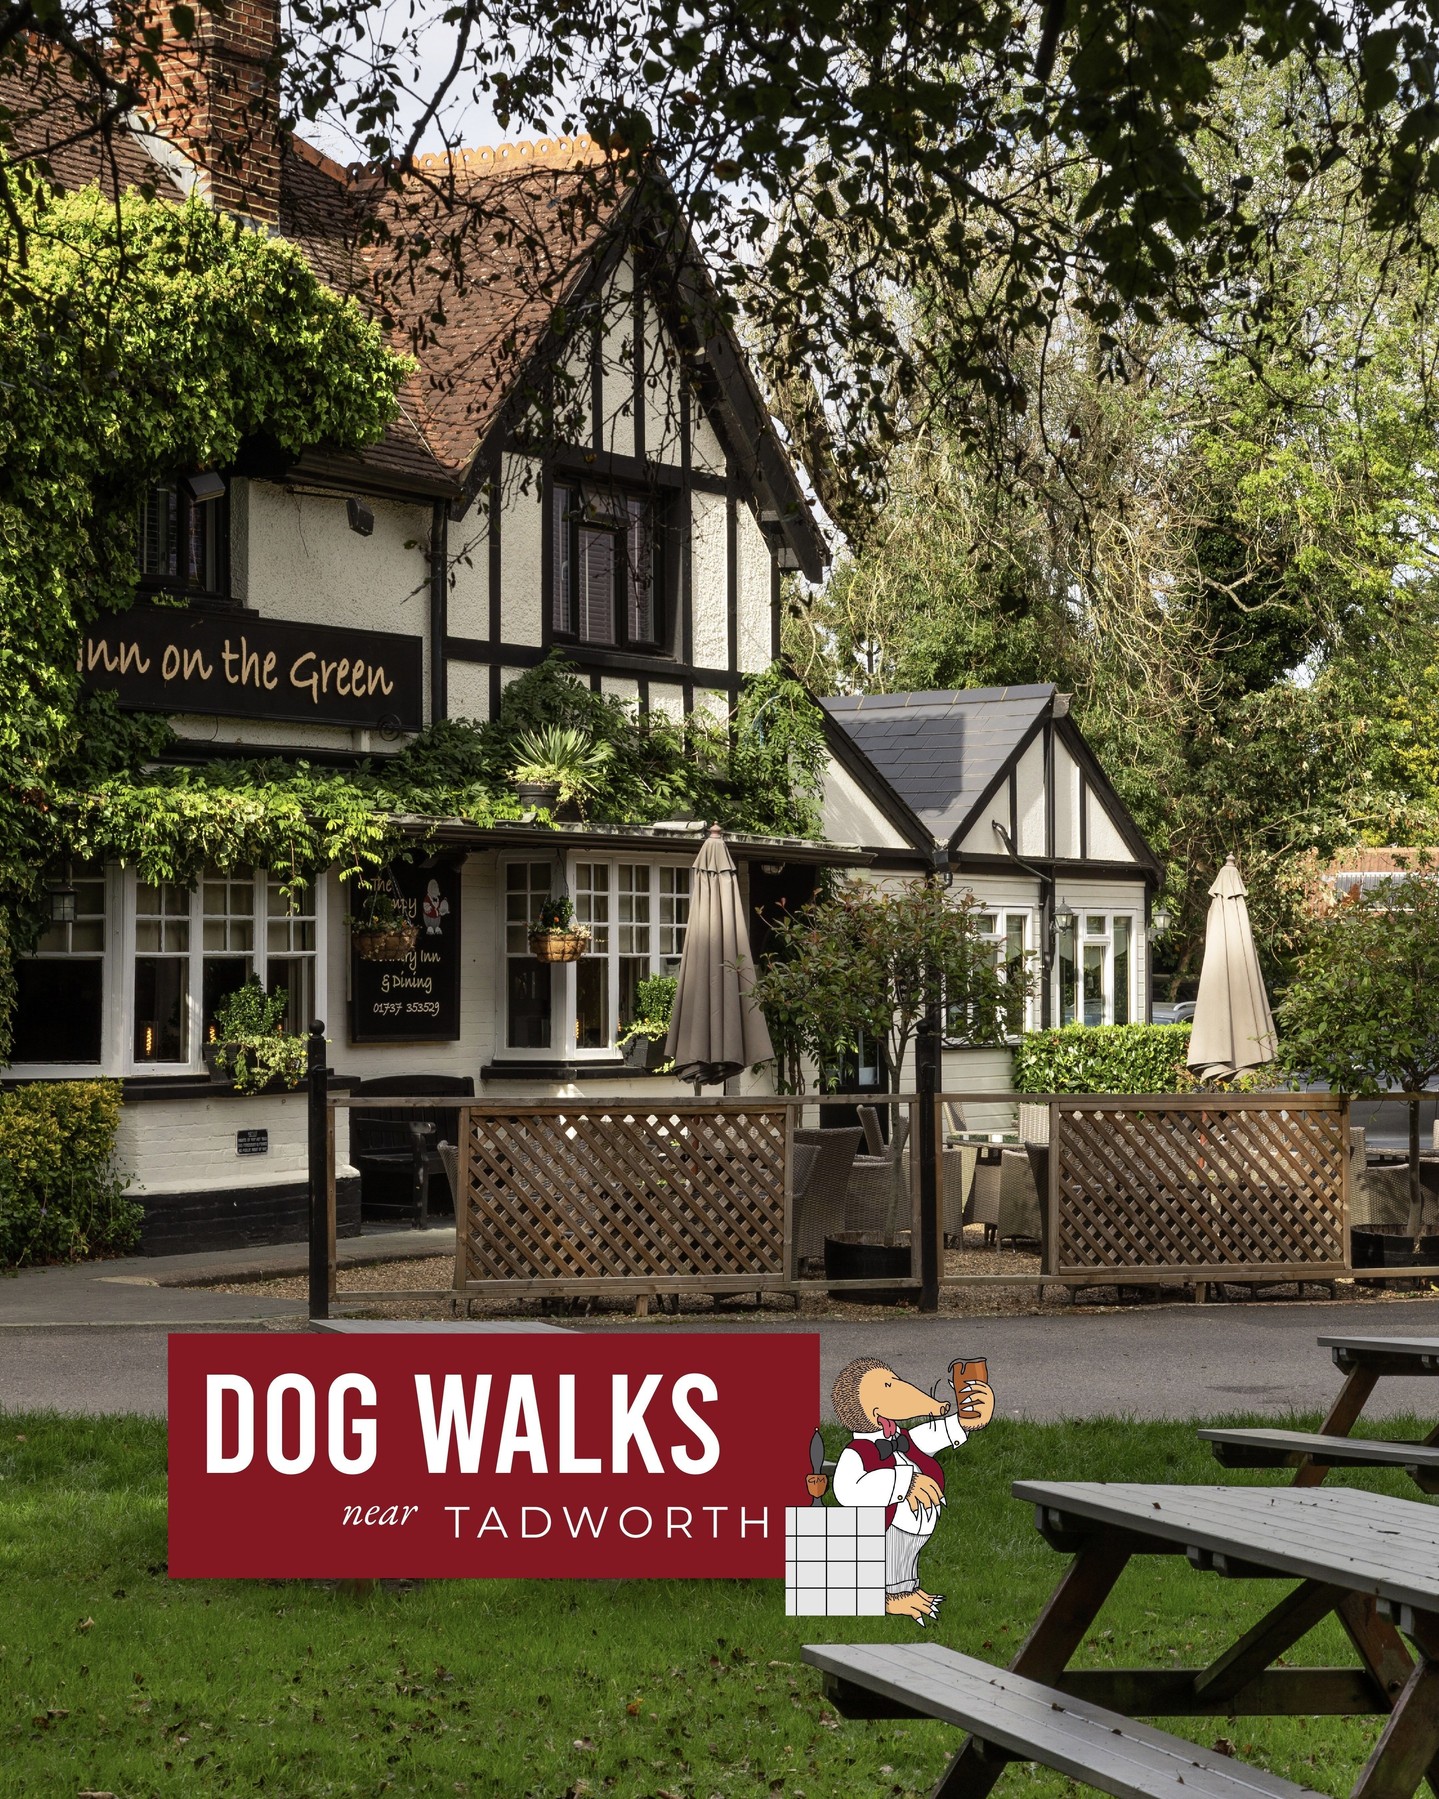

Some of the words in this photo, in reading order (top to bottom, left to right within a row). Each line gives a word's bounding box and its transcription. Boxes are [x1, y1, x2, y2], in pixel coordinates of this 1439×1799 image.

[162, 644, 213, 681] on
[221, 636, 278, 690] the
[290, 651, 394, 704] Green
[370, 877, 393, 893] The
[420, 949, 441, 963] Inn
[381, 974, 390, 993] &
[392, 971, 433, 994] Dining
[373, 1002, 403, 1016] 01737
[406, 1002, 440, 1017] 353529
